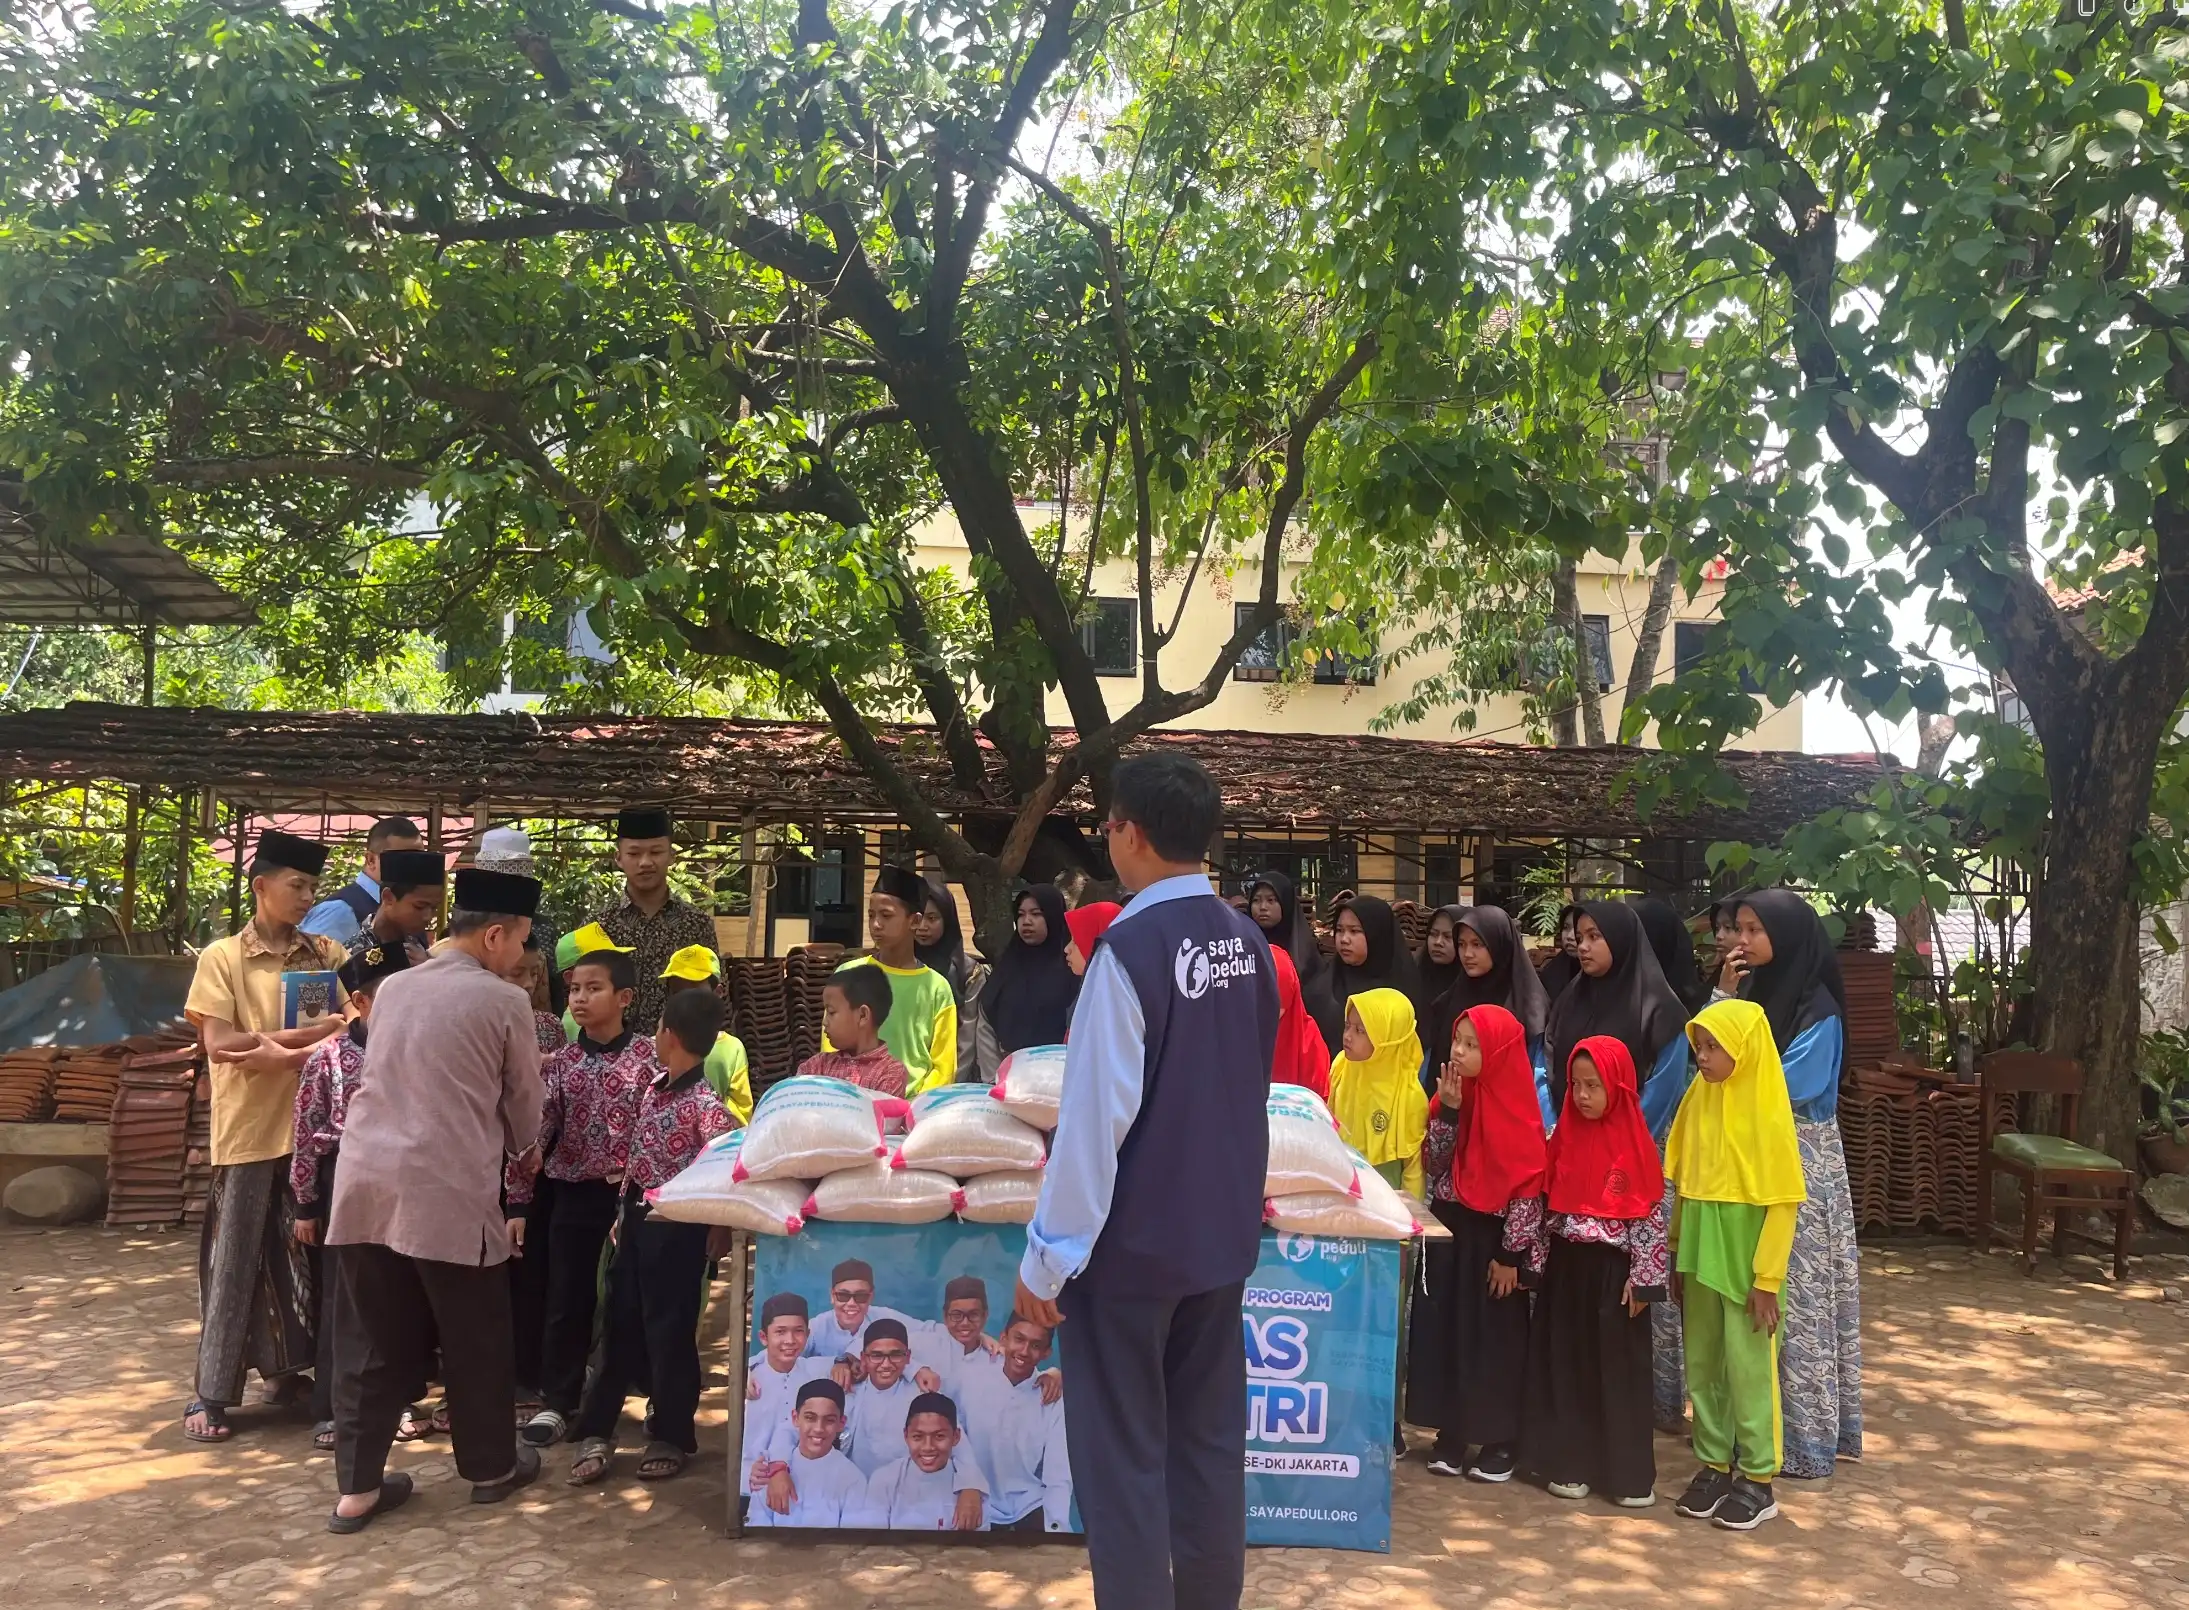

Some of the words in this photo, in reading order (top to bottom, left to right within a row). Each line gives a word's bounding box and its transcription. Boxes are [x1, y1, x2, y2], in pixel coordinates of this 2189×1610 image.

[1208, 937, 1244, 959] saya
[1210, 954, 1257, 987] peduli
[1214, 978, 1229, 988] .org
[1320, 1239, 1367, 1259] peduli
[1247, 1288, 1330, 1307] PROGRAM
[1288, 1460, 1349, 1472] JAKARTA
